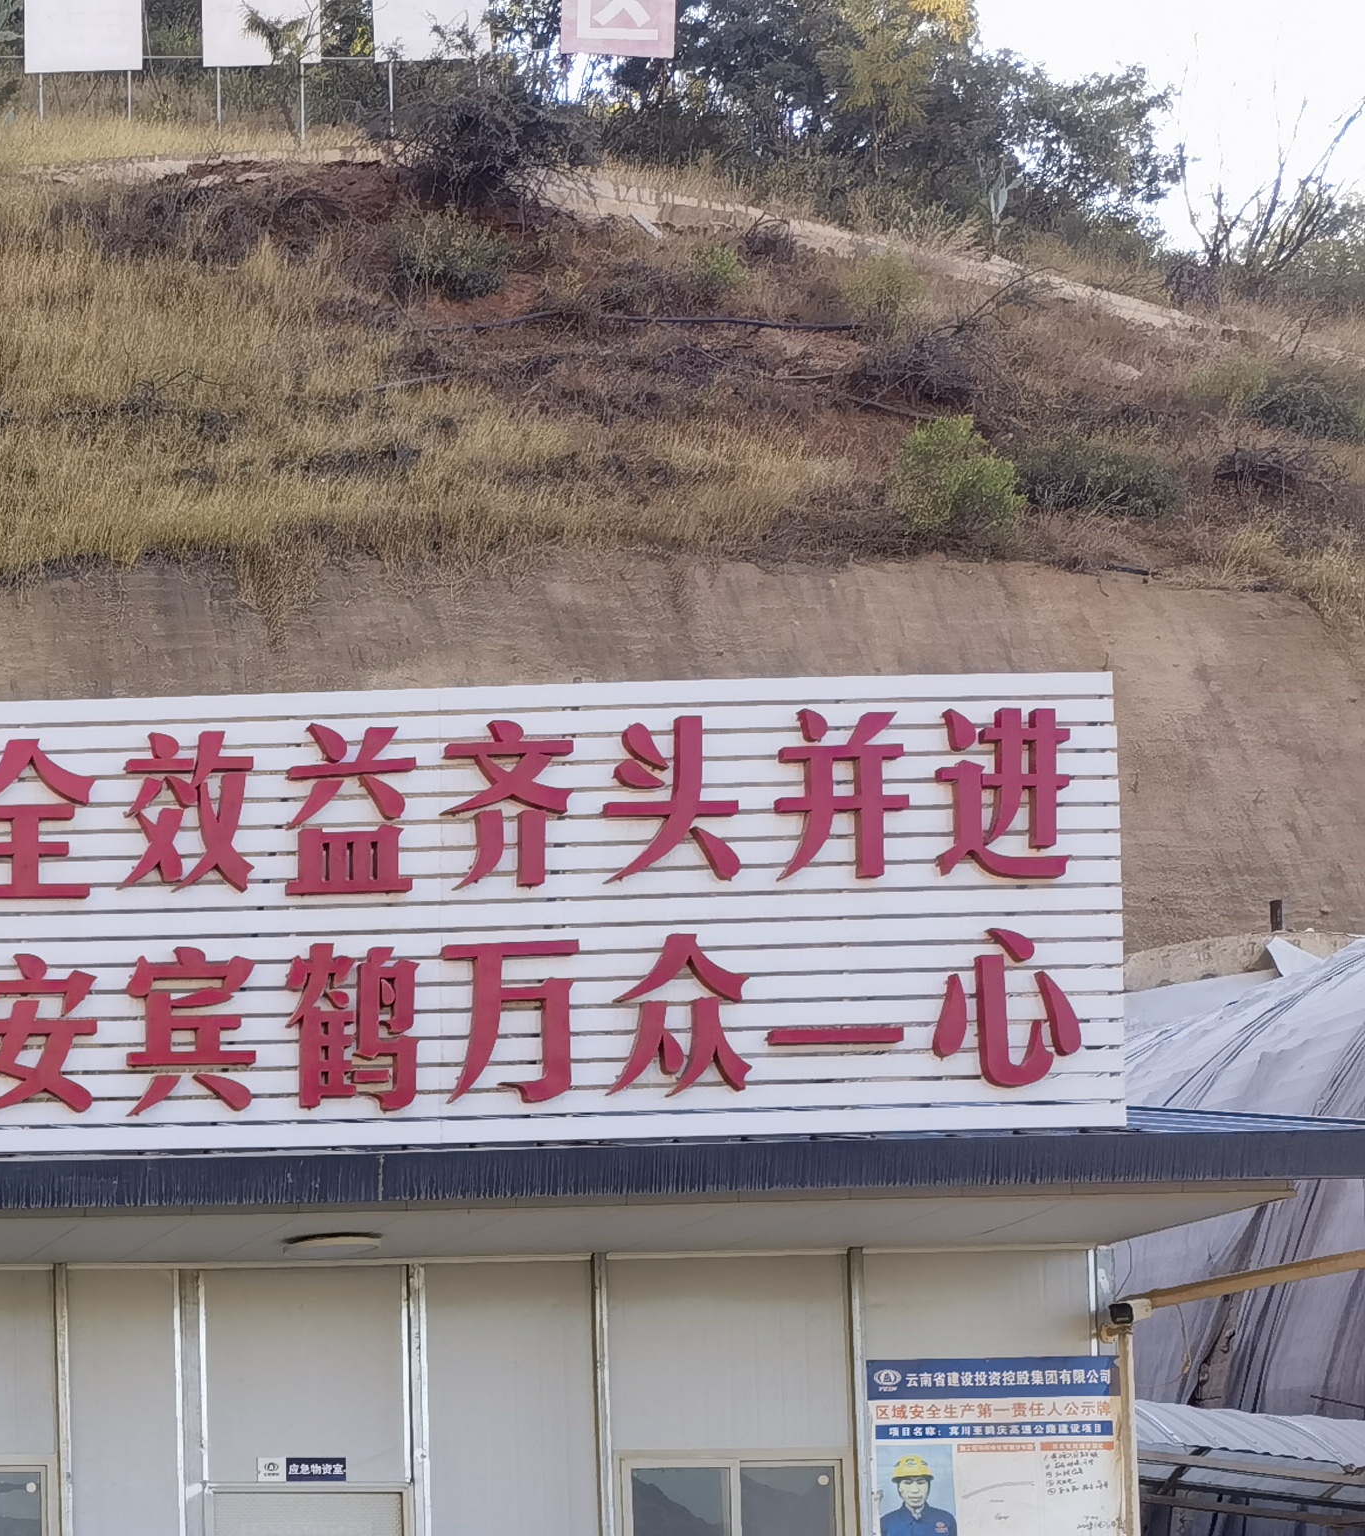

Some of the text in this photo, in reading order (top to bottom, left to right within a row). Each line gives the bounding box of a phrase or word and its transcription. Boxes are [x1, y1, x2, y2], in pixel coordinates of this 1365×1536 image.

[905, 1368, 1111, 1389] 云南省建设投资控股集团有限公司
[875, 1400, 1112, 1420] 区域安全生产第一责任人公示牌
[288, 1463, 344, 1475] 应急物资室
